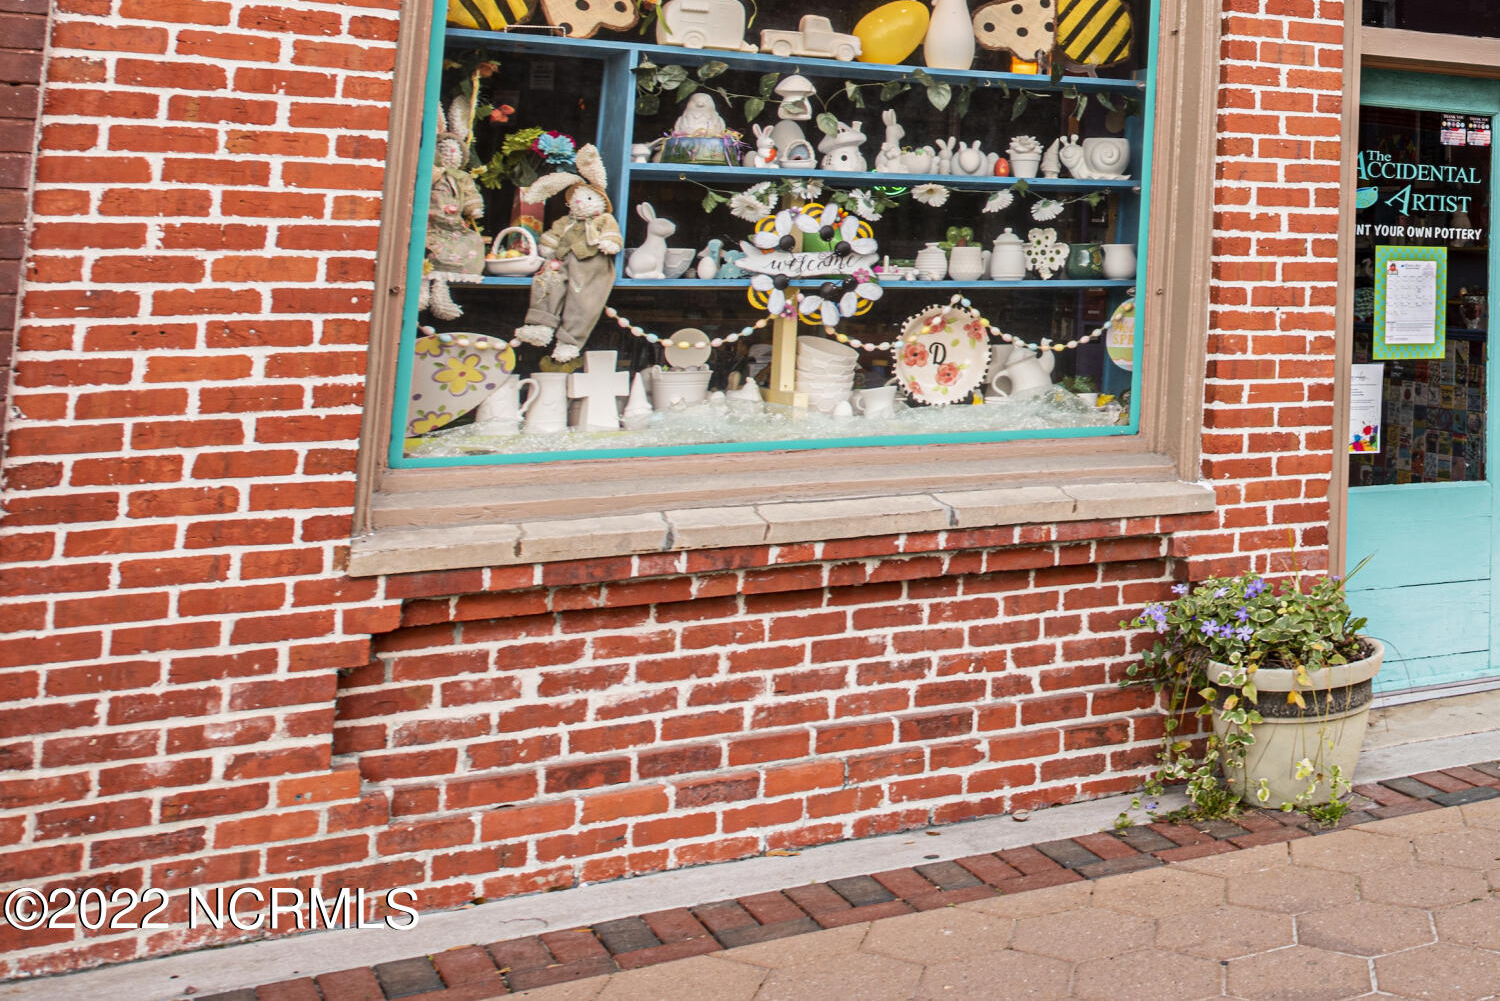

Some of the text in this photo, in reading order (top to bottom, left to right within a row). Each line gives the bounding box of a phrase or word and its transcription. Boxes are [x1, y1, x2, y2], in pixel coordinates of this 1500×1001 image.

[1366, 150, 1391, 162] The
[1384, 184, 1472, 216] ARTIST
[1374, 224, 1404, 237] YOUR
[1407, 226, 1432, 238] OWN
[1434, 228, 1482, 240] POTTERY
[765, 252, 863, 274] welcome
[929, 342, 947, 365] D
